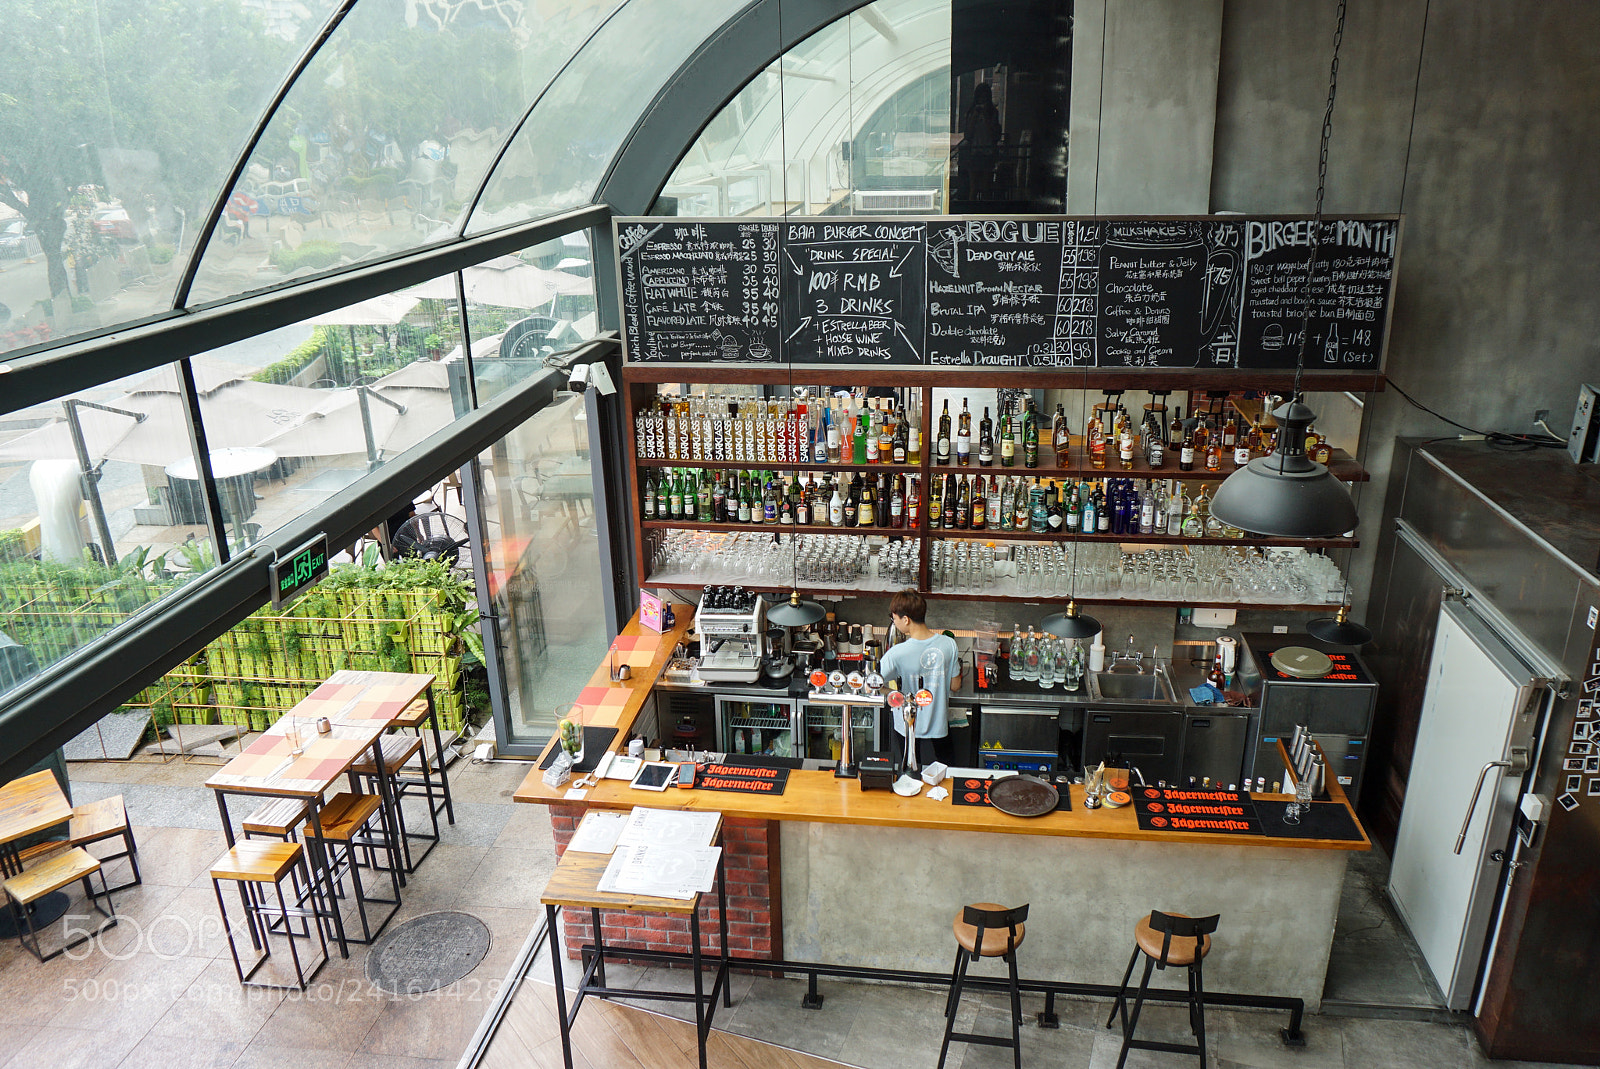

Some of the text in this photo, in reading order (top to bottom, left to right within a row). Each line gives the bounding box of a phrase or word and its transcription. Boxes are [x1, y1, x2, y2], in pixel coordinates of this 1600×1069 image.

[788, 224, 926, 241] BAIA BURGER CONCEPT
[966, 220, 1060, 243] ROGUE
[1113, 226, 1186, 238] MILKSHAKES
[1324, 220, 1396, 258] of MONTH
[742, 239, 756, 250] 25
[762, 238, 777, 250] 30
[1248, 220, 1323, 261] BURGER
[743, 251, 757, 261] 25
[763, 251, 777, 262] 30
[966, 248, 1036, 262] DEAD GUY ALE
[1063, 249, 1077, 264] 55
[642, 265, 685, 275] AMERICANO
[742, 264, 757, 275] 30
[763, 264, 777, 275] 50
[1176, 256, 1198, 271] Jelly
[1250, 263, 1265, 275] 180
[742, 275, 759, 287] 35
[762, 275, 779, 288] 40
[843, 272, 881, 291] RMB
[929, 280, 976, 295] HAZELNUT
[1060, 272, 1075, 290] 55
[1105, 282, 1154, 293] Chocolate
[644, 287, 666, 300] FLAT
[667, 287, 699, 300] WHITE
[742, 287, 759, 300] 35
[763, 286, 780, 300] 40
[672, 301, 697, 314] LATE
[742, 301, 760, 316] 35
[762, 301, 779, 316] 40
[816, 297, 894, 315] 3 DRINKS
[966, 304, 987, 317] IPA
[1058, 297, 1094, 313] 60 218
[1105, 305, 1131, 316] Coffee
[1251, 307, 1283, 318] toasted
[1319, 306, 1336, 318] bun
[742, 314, 759, 328] 40
[762, 315, 778, 328] 45
[822, 319, 891, 334] ESTRELLA BEER
[1056, 319, 1093, 336] 60 218
[930, 322, 964, 337] Double
[825, 332, 883, 345] HOUSE WINE
[1352, 329, 1371, 347] 148
[827, 345, 892, 360] MIXED DRINKS
[930, 349, 972, 365] Estrella
[1073, 342, 1092, 360] 98
[1343, 350, 1374, 363] (Set)
[1057, 356, 1071, 367] 40
[311, 553, 325, 570] EXIT
